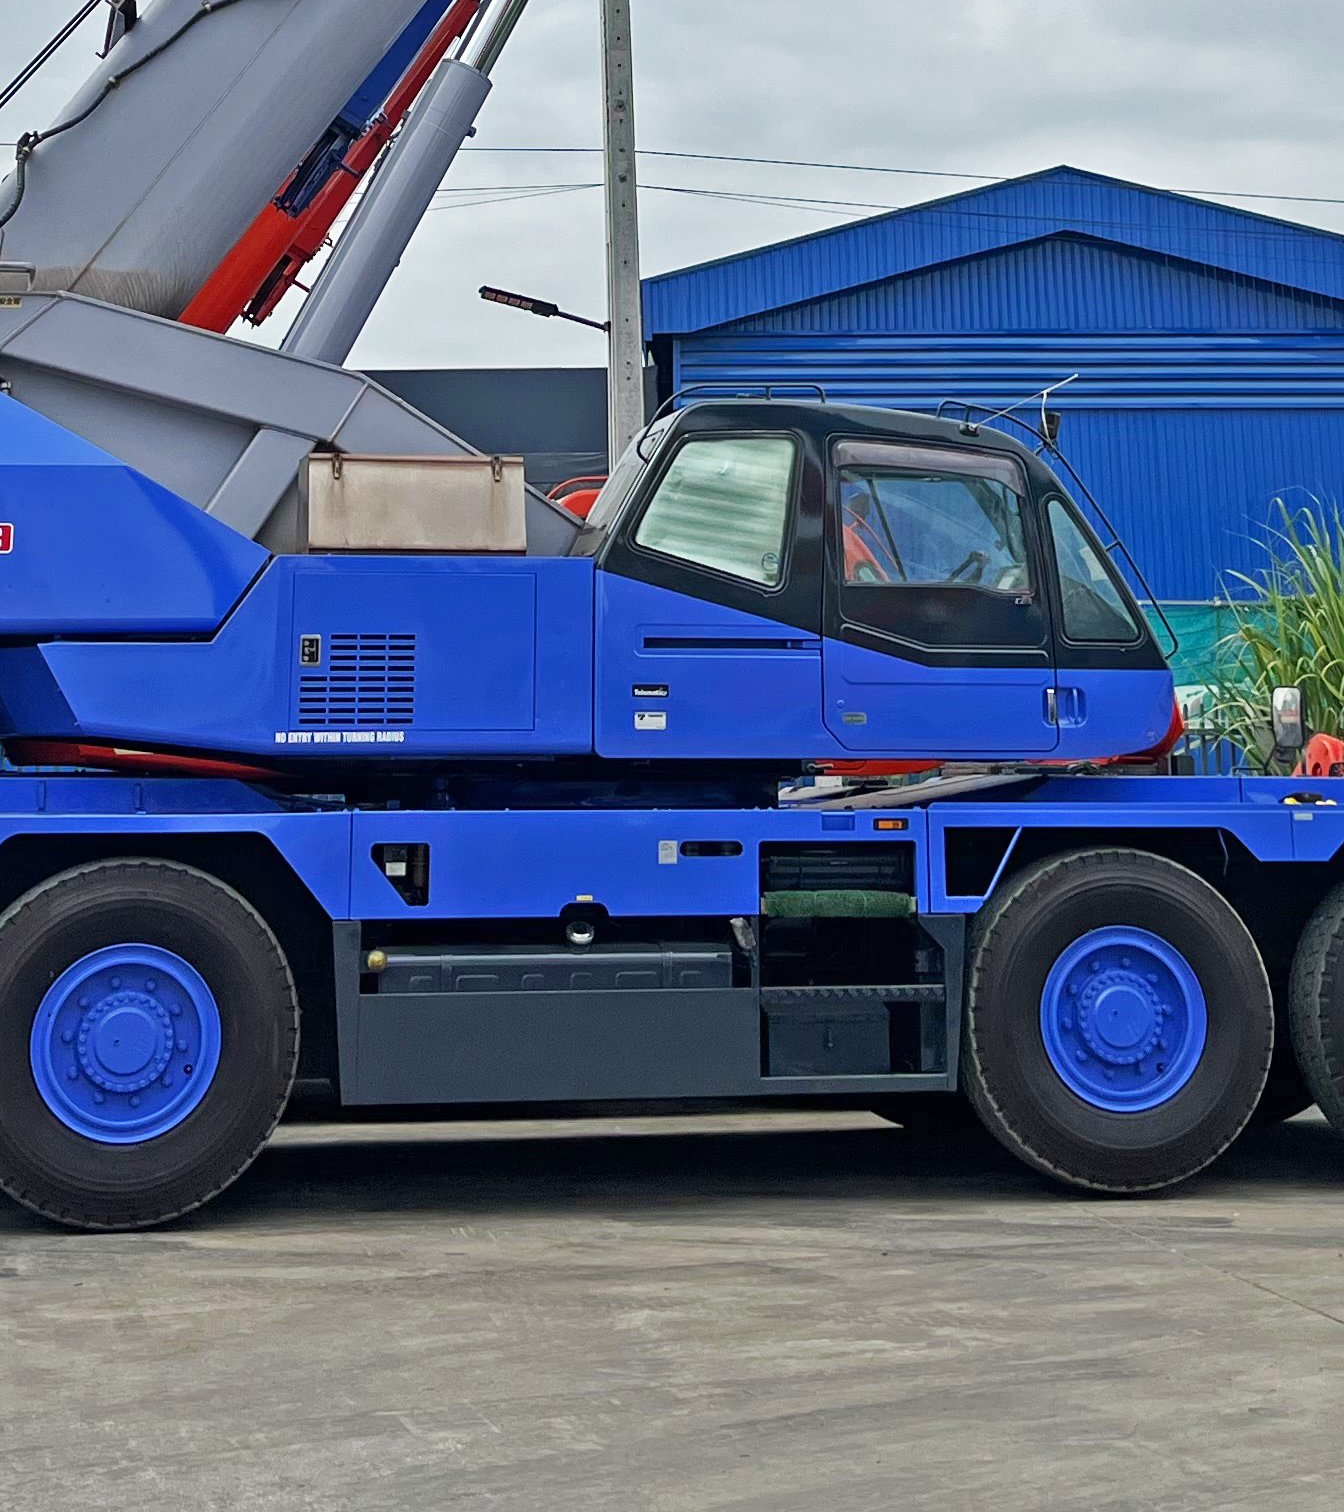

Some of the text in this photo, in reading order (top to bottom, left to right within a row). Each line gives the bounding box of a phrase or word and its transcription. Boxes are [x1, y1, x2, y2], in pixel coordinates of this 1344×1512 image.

[275, 731, 404, 743] NO ENTRY WITHIN TURNING RADIUS
